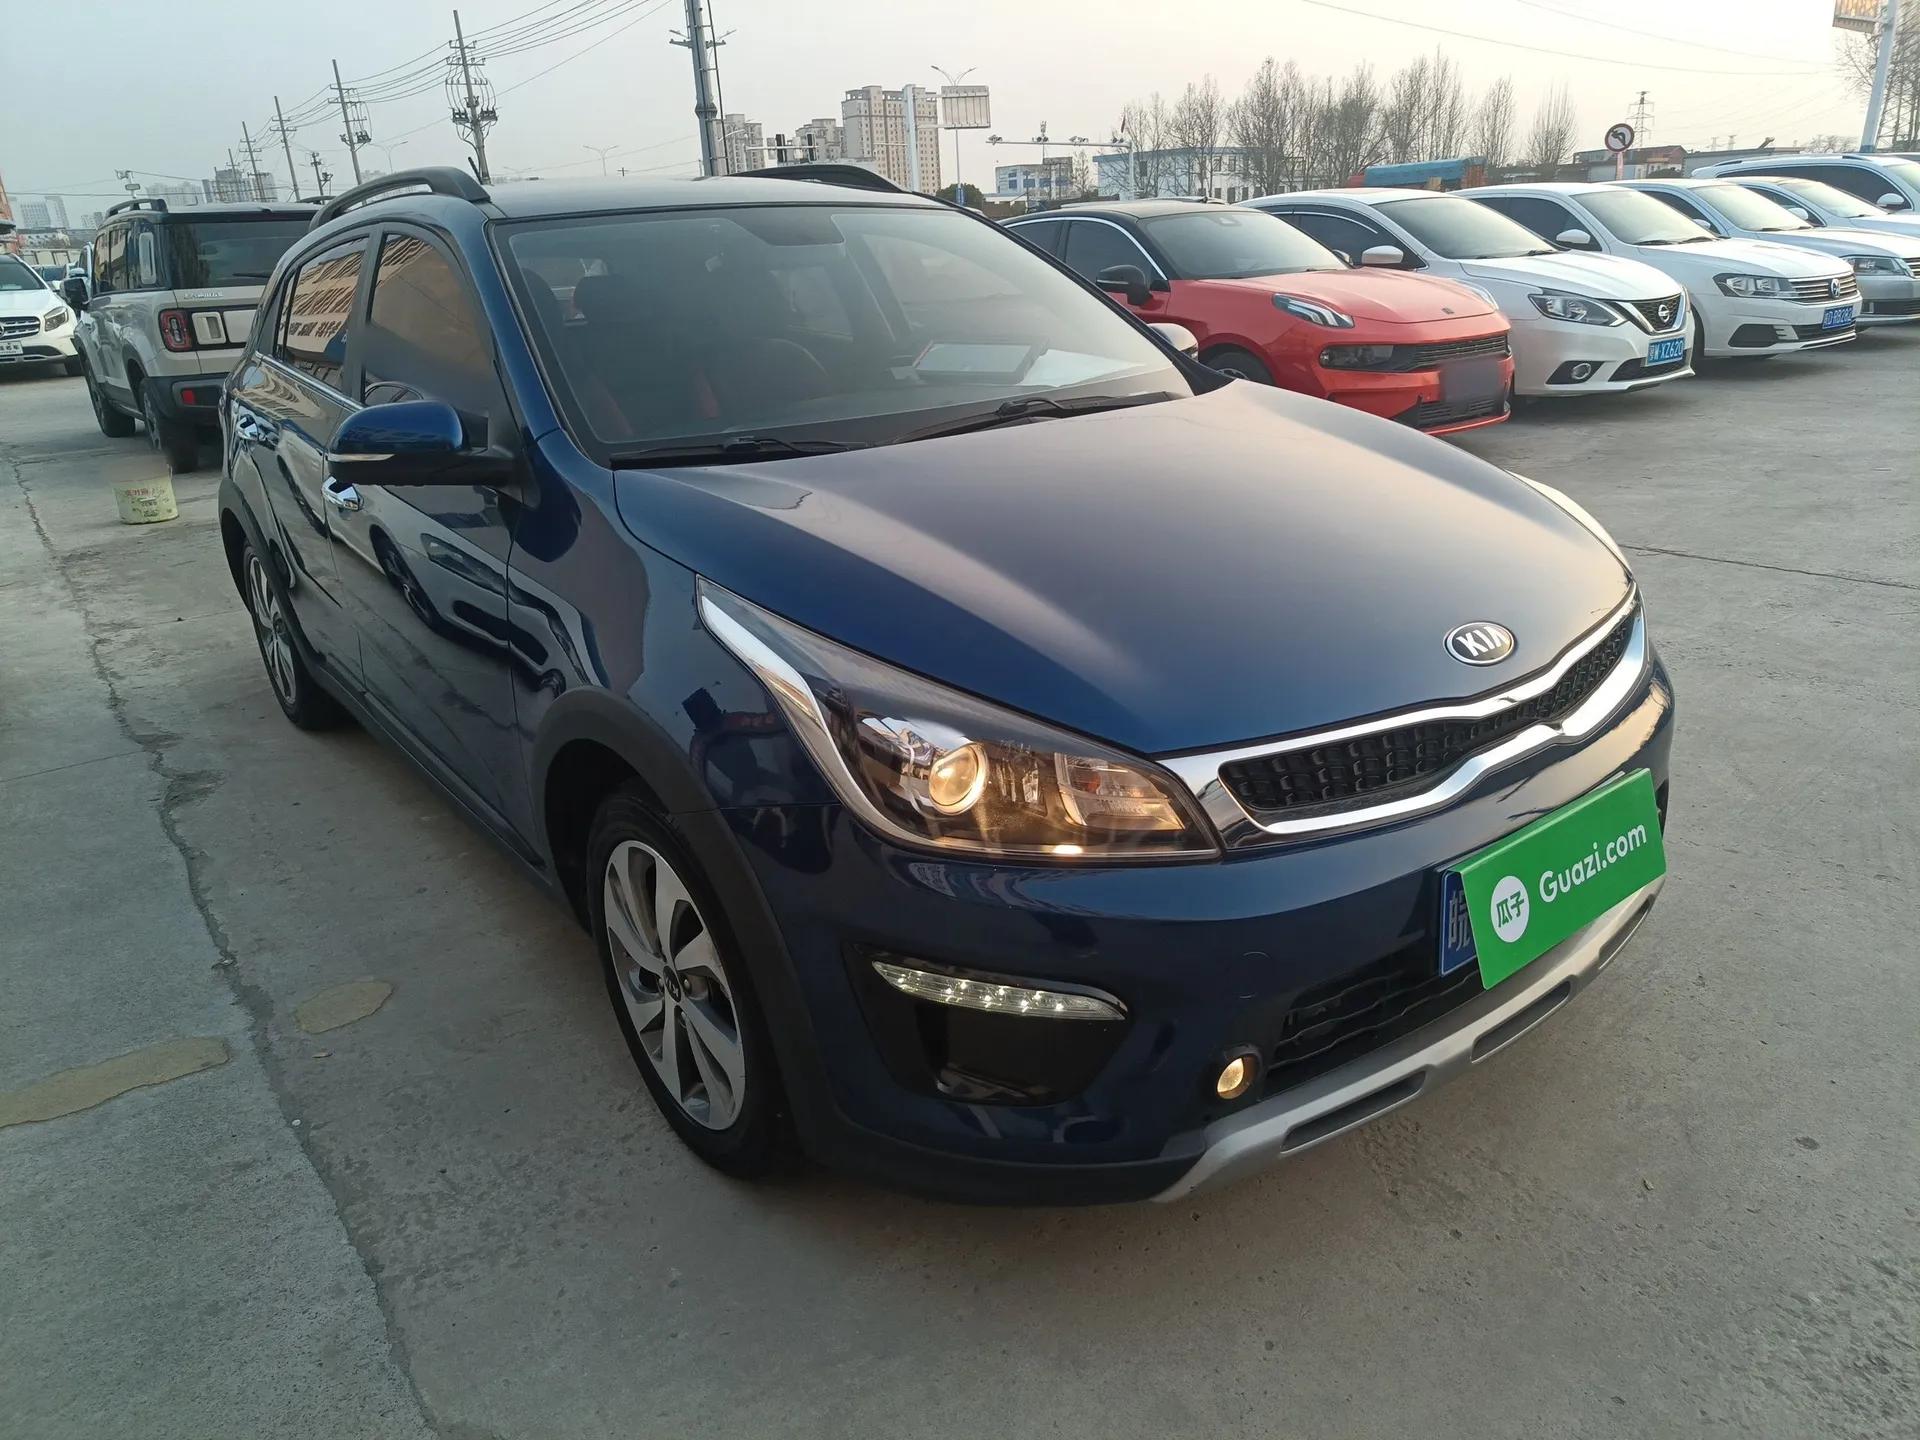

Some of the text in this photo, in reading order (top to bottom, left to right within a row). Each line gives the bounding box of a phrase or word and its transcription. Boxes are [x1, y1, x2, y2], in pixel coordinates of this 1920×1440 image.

[1456, 626, 1511, 657] KIA
[1539, 824, 1647, 903] Guazi.com
[1496, 890, 1525, 928] 瓜子
